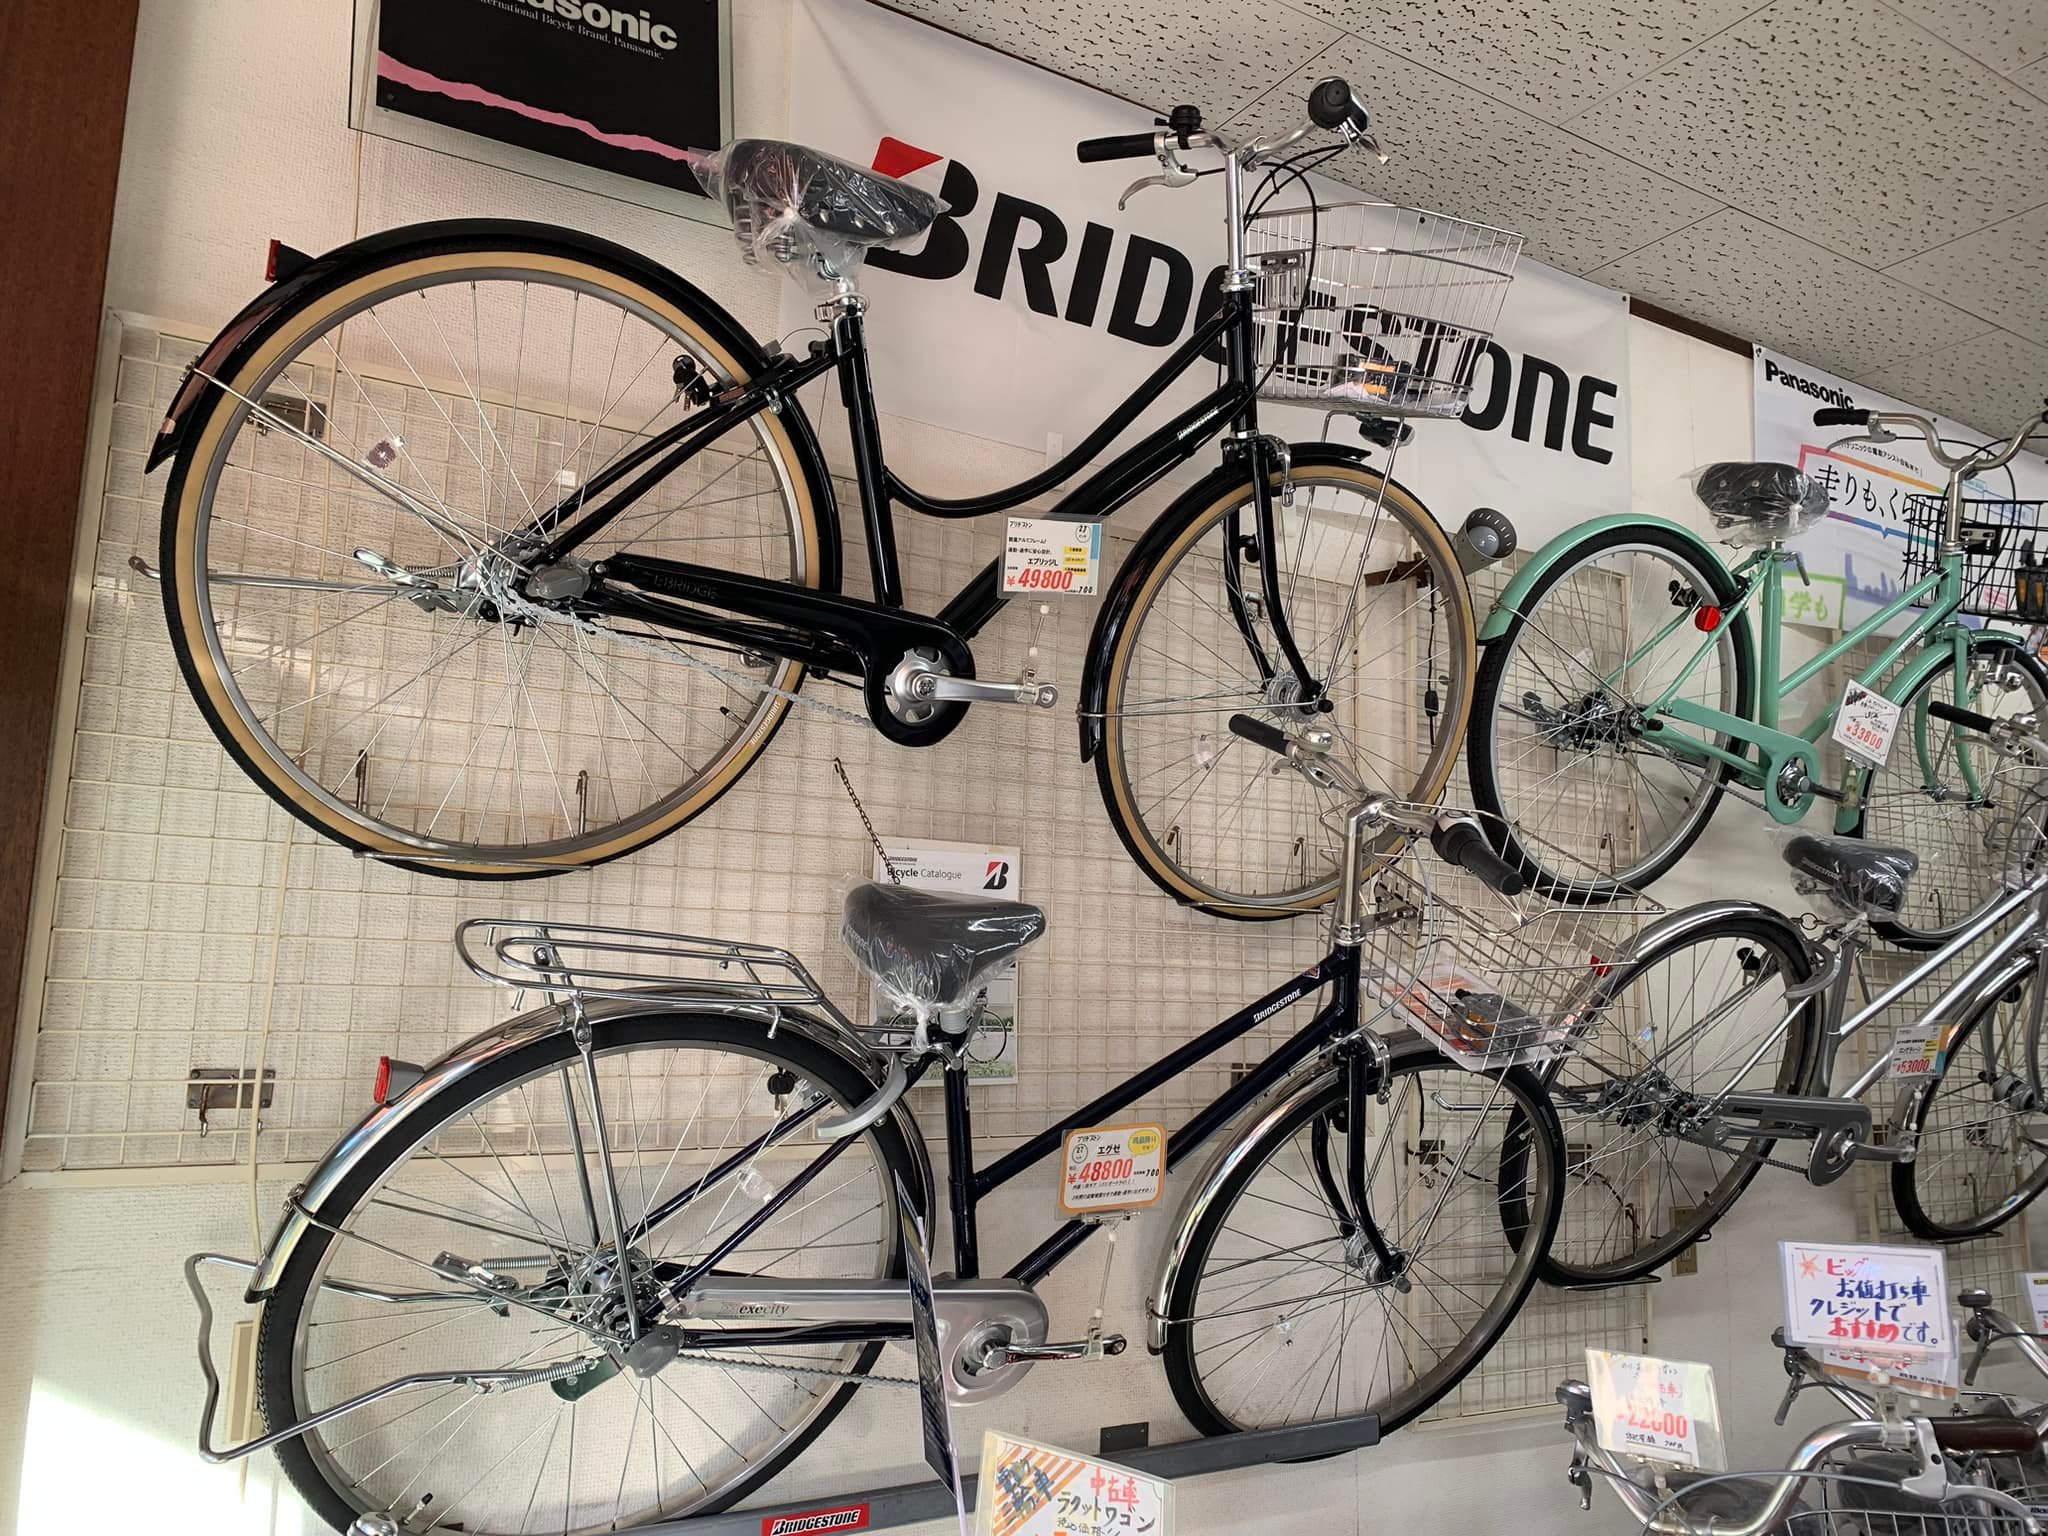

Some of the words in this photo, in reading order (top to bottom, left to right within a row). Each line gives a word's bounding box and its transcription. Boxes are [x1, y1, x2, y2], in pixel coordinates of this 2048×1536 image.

[541, 13, 576, 32] Bicycle
[1764, 358, 1854, 410] Panasonic
[887, 866, 919, 879] Bcycle
[920, 868, 963, 881] Catalogue
[1252, 988, 1302, 1023] BRIDGESTONE
[1836, 1275, 1932, 1307] お値打ち車
[738, 1302, 790, 1317] execity
[1809, 1298, 1907, 1323] クレジットで
[770, 1509, 861, 1536] BRIDGESTONE
